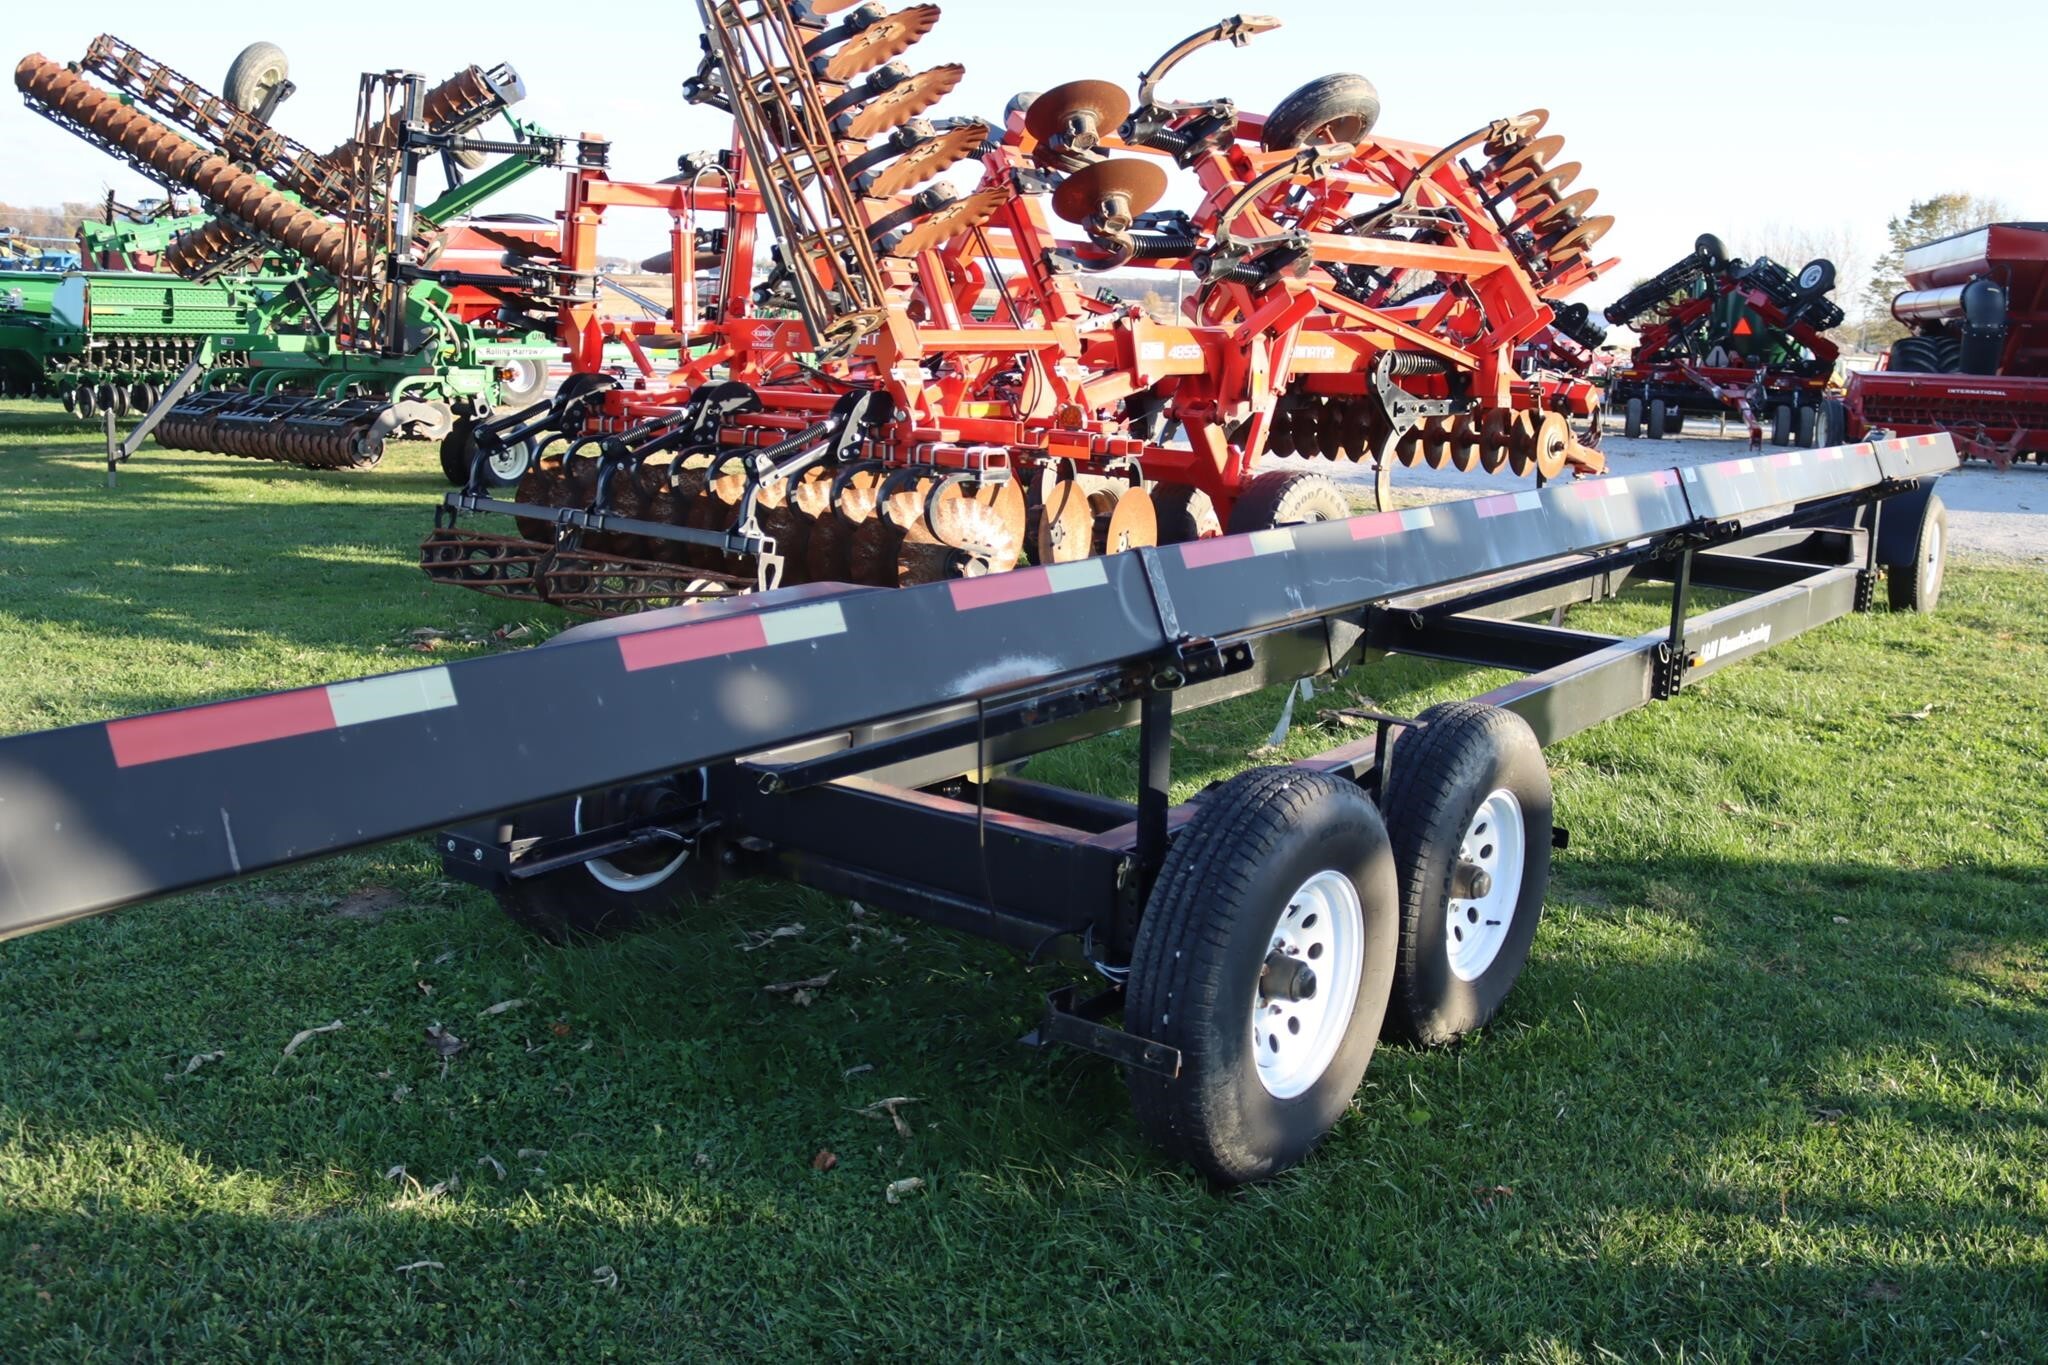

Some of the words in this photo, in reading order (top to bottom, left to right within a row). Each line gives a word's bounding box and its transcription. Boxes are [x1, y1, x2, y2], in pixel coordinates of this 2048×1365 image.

[485, 347, 511, 357] Rolling
[512, 348, 539, 356] Harrow
[1168, 344, 1201, 359] 4855
[1947, 388, 2007, 396] INTERNATIONAL
[1717, 623, 1773, 656] Manufacturing
